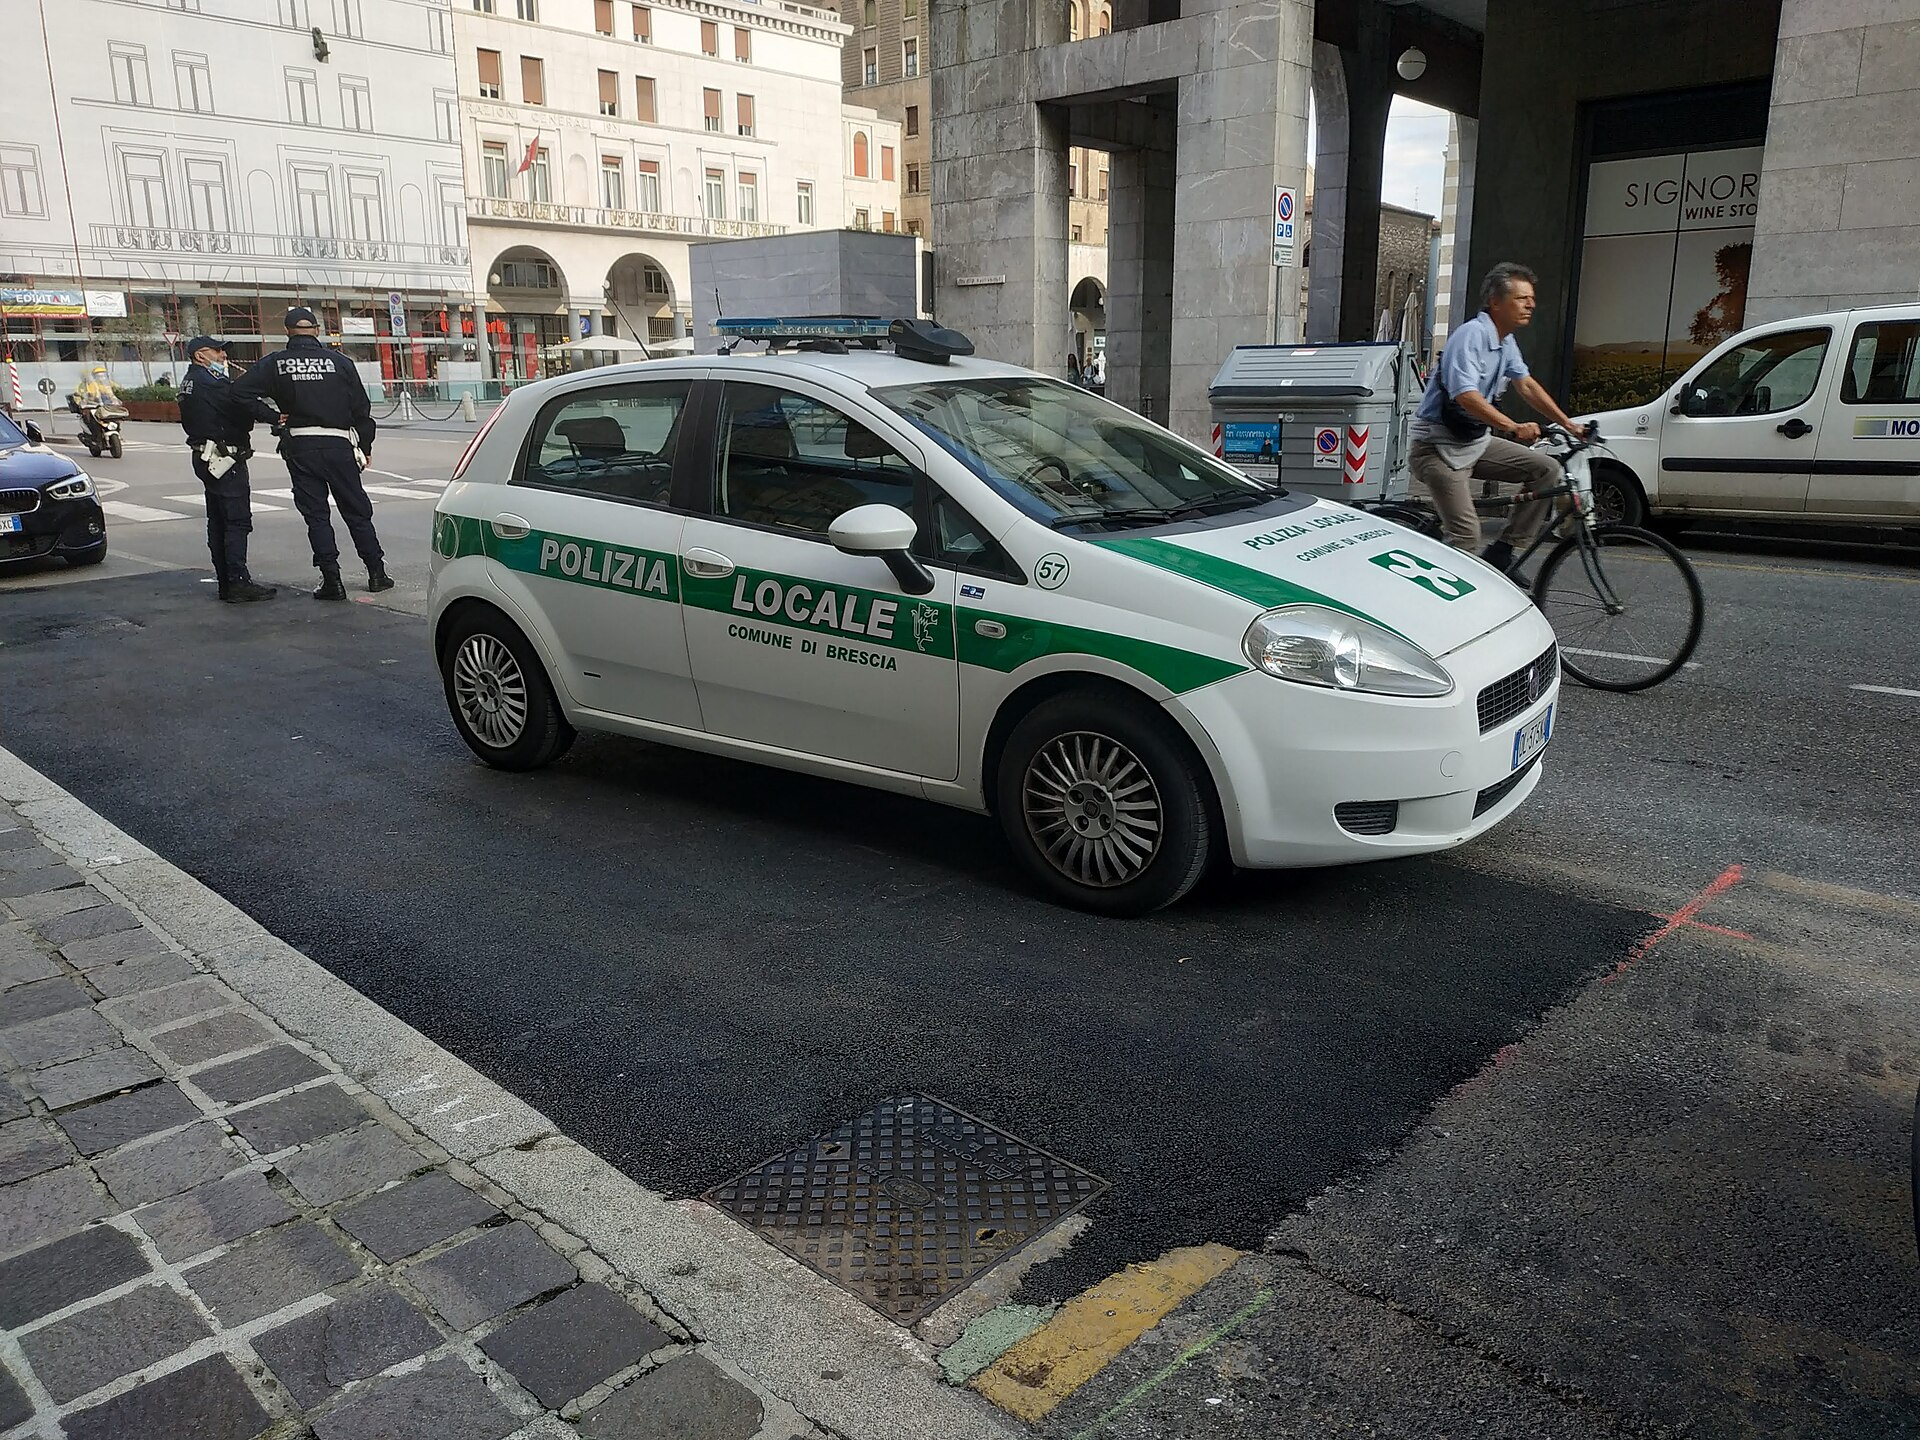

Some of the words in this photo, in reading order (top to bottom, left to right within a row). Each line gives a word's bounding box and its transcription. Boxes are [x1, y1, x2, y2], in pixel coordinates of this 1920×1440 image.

[1625, 173, 1758, 207] SIGNOR
[1685, 205, 1725, 220] WINE
[1729, 203, 1758, 217] STO
[277, 357, 335, 369] POLIZIA
[279, 364, 336, 375] LOCALE
[1891, 420, 1920, 435] MO
[0, 520, 12, 530] XC
[1243, 525, 1312, 551] POLIZIA
[1306, 513, 1363, 529] LOCALE
[1296, 541, 1345, 562] COMUNE
[1342, 537, 1359, 545] DI
[1354, 528, 1394, 542] BRESCIA
[1039, 560, 1066, 581] 57
[539, 538, 669, 595] POLIZIA
[731, 574, 899, 640] LOCALE
[728, 624, 793, 650] COMUNE
[800, 639, 817, 655] DI
[826, 644, 897, 671] BRESCIA
